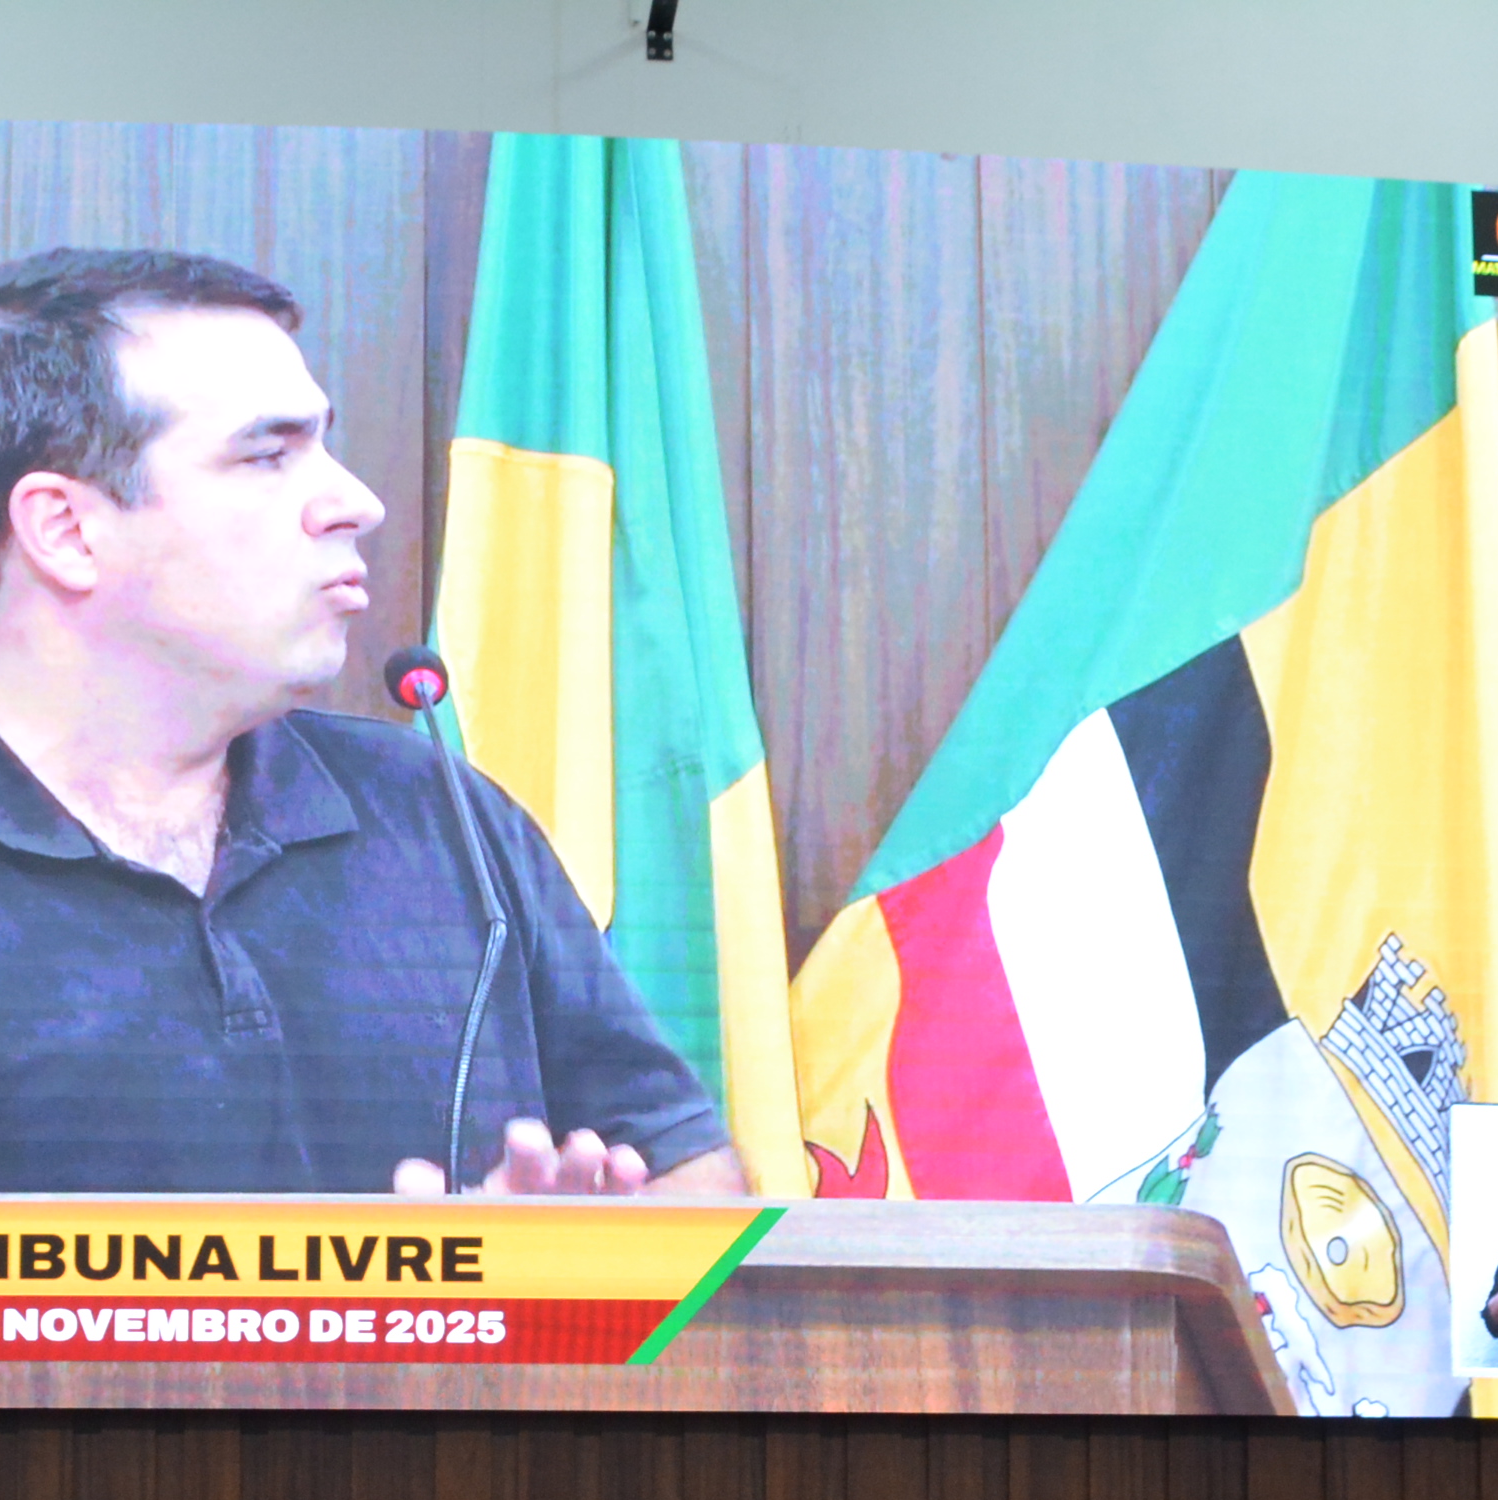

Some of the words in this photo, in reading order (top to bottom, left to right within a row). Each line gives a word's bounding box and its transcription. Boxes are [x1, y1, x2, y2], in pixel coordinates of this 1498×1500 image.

[259, 1235, 484, 1282] LIVRE
[2, 1308, 300, 1343] NOVEMBRO
[309, 1309, 377, 1343] DE
[385, 1310, 507, 1344] 2025
